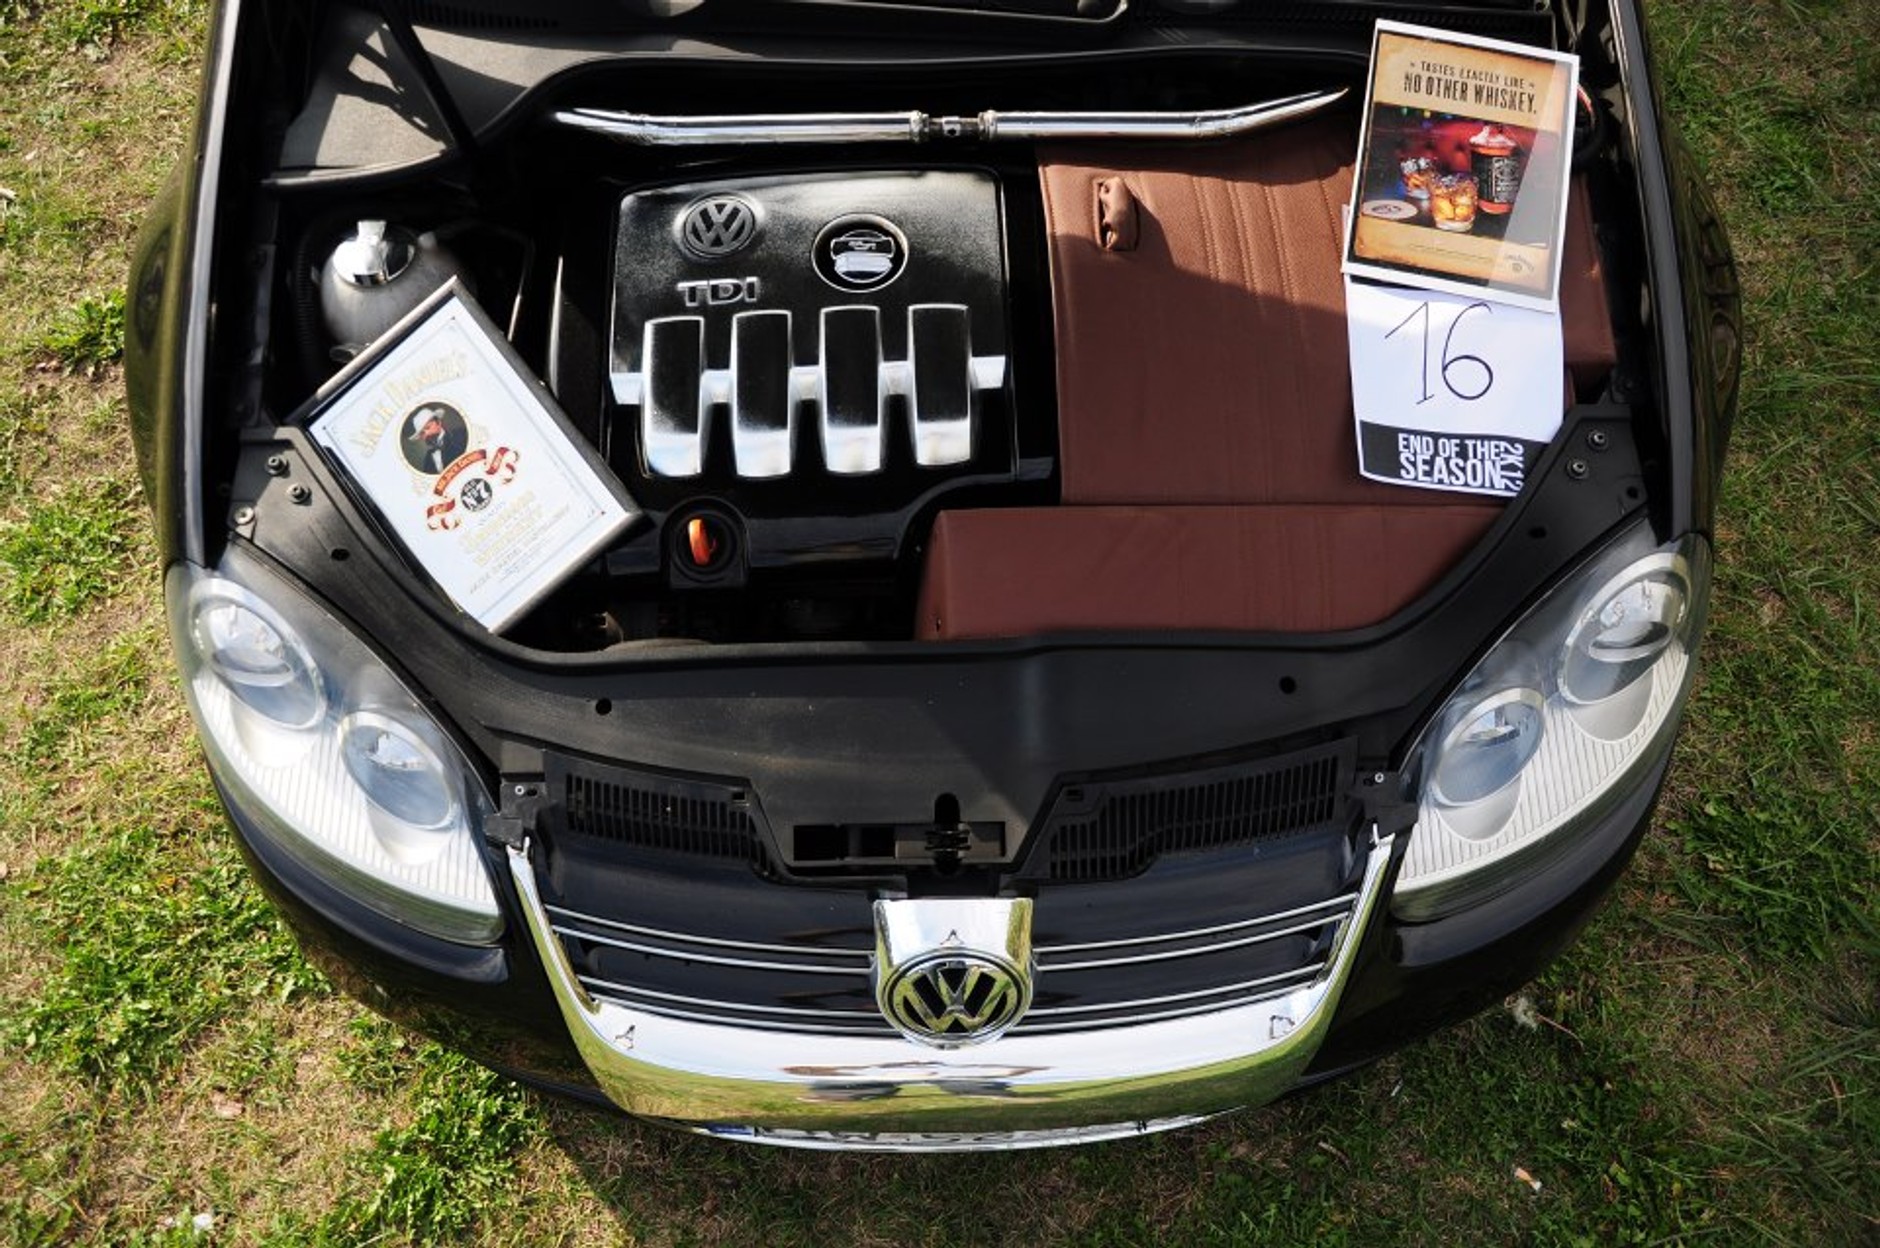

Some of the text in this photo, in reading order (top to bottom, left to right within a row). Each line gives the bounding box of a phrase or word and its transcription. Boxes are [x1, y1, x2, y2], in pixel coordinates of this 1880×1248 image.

[1404, 72, 1537, 114] NO OTHER WHISKEY.
[1420, 61, 1526, 89] TASTES EXACTLY LIKE
[677, 276, 758, 307] TDI
[1384, 301, 1494, 405] 16
[1398, 433, 1501, 461] END OF THE
[1500, 441, 1524, 491] 2K12
[1400, 452, 1501, 490] SEASON
